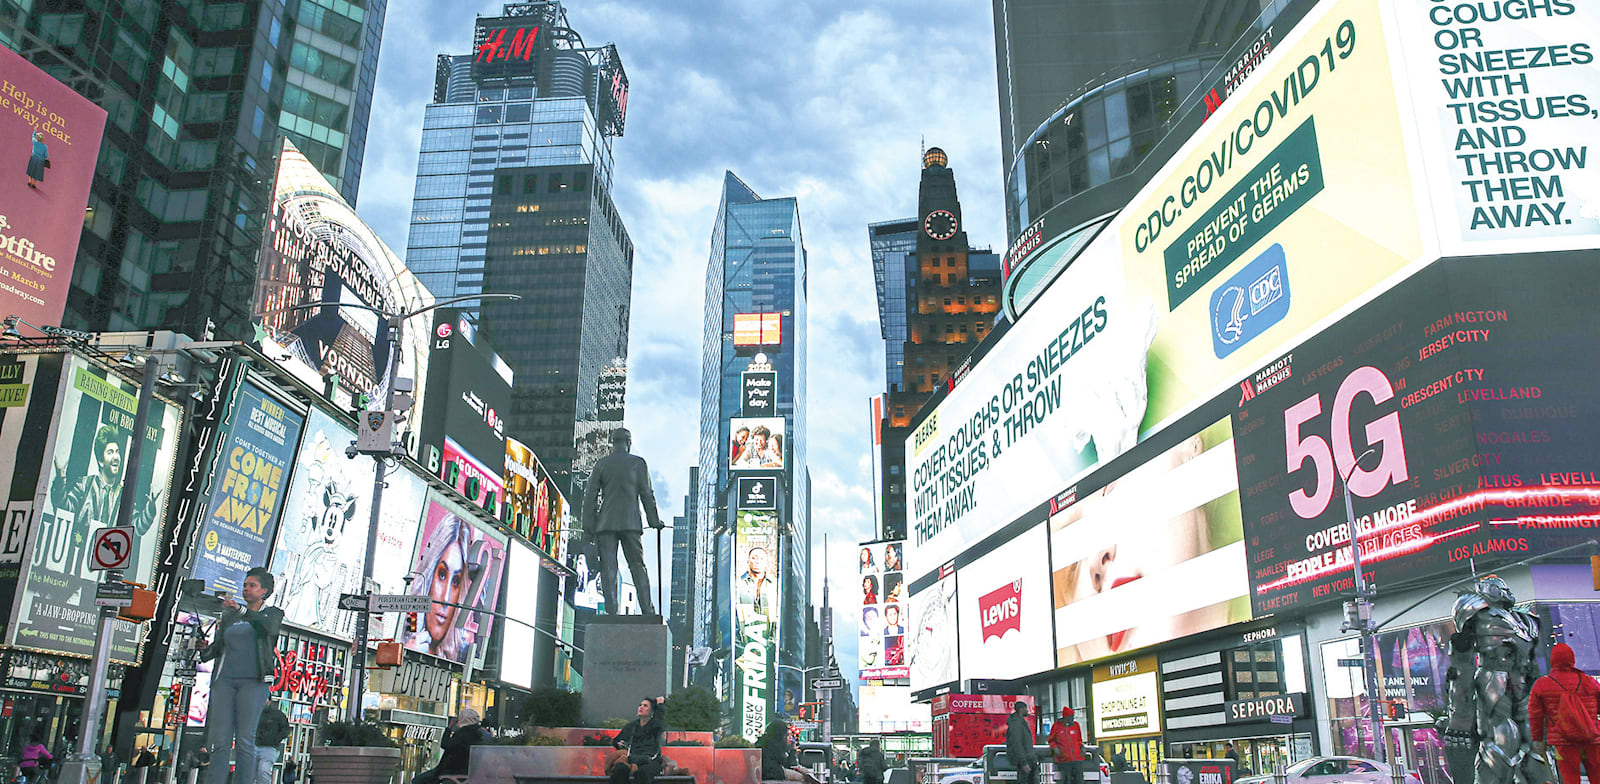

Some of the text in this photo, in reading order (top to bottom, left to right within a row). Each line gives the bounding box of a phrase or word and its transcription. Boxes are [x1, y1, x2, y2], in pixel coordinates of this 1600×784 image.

[476, 27, 539, 63] H&M
[1434, 27, 1484, 50] OR
[1223, 26, 1274, 85] MARRIOTT
[1438, 43, 1594, 75] SNEEZES
[1225, 47, 1271, 98] MARQUIS
[1441, 73, 1529, 99] WITH
[1, 80, 66, 128] Help is on
[1446, 94, 1599, 124] TISSUES,
[13, 103, 72, 146] way, dear.
[1134, 19, 1356, 254] CDC.GOV/COVID19
[1455, 125, 1526, 150] AND
[1456, 146, 1587, 176] THROW
[1461, 175, 1564, 202] THEM
[1187, 162, 1282, 258] PREVENT THE
[1470, 202, 1572, 230] AWAY.
[1009, 218, 1046, 257] MARRIOTT
[1174, 163, 1311, 290] SPREAD OF GERMS
[282, 207, 382, 311] MOST SUSTAINABLE
[329, 230, 351, 261] NEW
[351, 253, 371, 285] YORK
[1010, 234, 1042, 270] MARQUIS
[11, 271, 46, 292] March 9
[1251, 271, 1281, 304] CDC
[46, 327, 90, 338] LAMAR
[436, 340, 450, 349] LG
[319, 339, 381, 400] VORNADO
[1256, 353, 1293, 382] MARRIOTT
[1256, 367, 1290, 394] MARQUIS
[81, 374, 134, 412] RAISING SPIRITS
[746, 379, 772, 387] Make
[748, 388, 769, 398] your
[914, 295, 1108, 493] COVER COUGHS OR SNEEZES
[1401, 375, 1453, 409] CRESCENT
[1458, 386, 1542, 404] LEVELLAND
[109, 410, 119, 424] ON
[250, 407, 287, 439] BEST MUSICAL
[260, 397, 285, 422] WINNER!
[494, 415, 503, 433] LG
[914, 414, 937, 450] PLEASE
[914, 374, 1063, 520] WITH TISSUES, & THROW
[1284, 366, 1409, 519] 5G
[1476, 430, 1551, 445] NOGALES
[235, 436, 285, 468] COME TOGETHER AT
[1433, 453, 1503, 481] SILVER CITY
[230, 446, 283, 491] COME
[221, 468, 277, 514] FROM
[424, 444, 556, 557] BROADWAY
[1058, 485, 1077, 501] MARRIOTT
[1439, 482, 1464, 501] CITY
[1477, 473, 1523, 489] ALTUS
[213, 496, 272, 535] AWAY
[914, 481, 977, 548] THEM AWAY.
[1305, 516, 1374, 552] COVERING
[1374, 499, 1417, 530] MORE
[1422, 495, 1572, 529] SILVER CITY GRANDE
[211, 518, 265, 544] THE REMARKABLE TRUE STORY
[1286, 551, 1334, 581] PEOPLE
[1365, 524, 1424, 556] PLACES
[1449, 545, 1471, 563] LOS
[1473, 538, 1529, 557] ALAMOS
[30, 570, 42, 582] The
[43, 575, 69, 588] Musical
[1312, 584, 1332, 598] NEW
[1331, 577, 1355, 593] YORK
[43, 605, 97, 626] JAW-DROPPING
[346, 599, 359, 607] ONE
[1262, 592, 1298, 611] LAKE CITY
[1243, 628, 1276, 643] SEPHORA
[743, 604, 768, 700] FRIDAY
[392, 661, 450, 701] FOREVER
[1109, 660, 1138, 677] INVICTA
[31, 680, 50, 689] Nikon
[53, 683, 75, 692] Canon
[1231, 696, 1295, 719] SEPHORA
[403, 725, 428, 739] FOREVER
[1200, 772, 1222, 784] ERIKA
